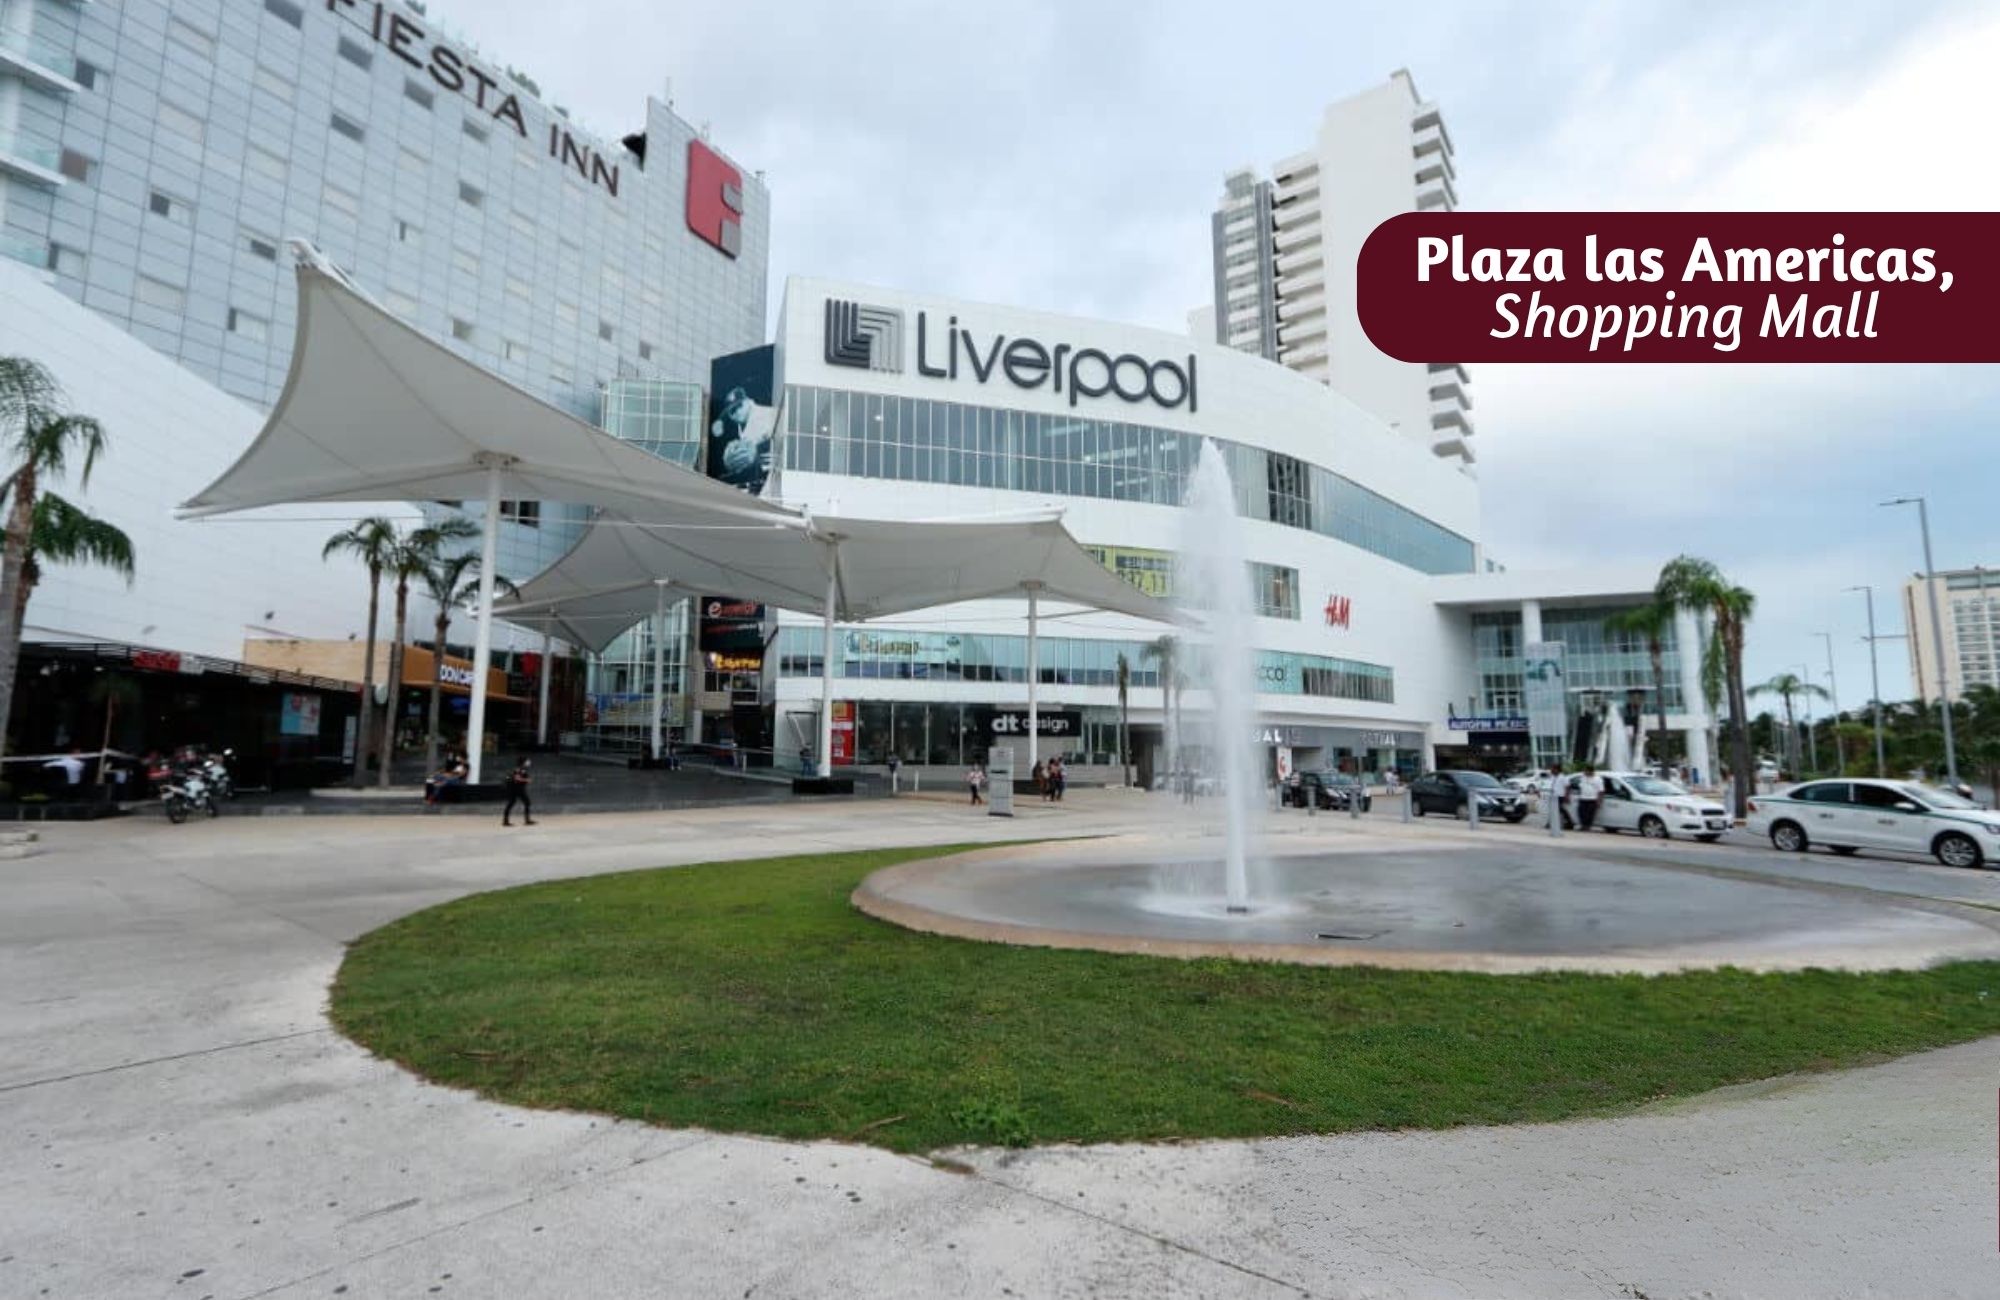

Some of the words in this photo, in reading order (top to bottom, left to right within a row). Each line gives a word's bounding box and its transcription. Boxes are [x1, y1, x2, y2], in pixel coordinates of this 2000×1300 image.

[550, 123, 619, 198] INN
[917, 310, 1198, 413] Liverpool
[991, 713, 1019, 733] dt
[1021, 715, 1070, 733] dsign
